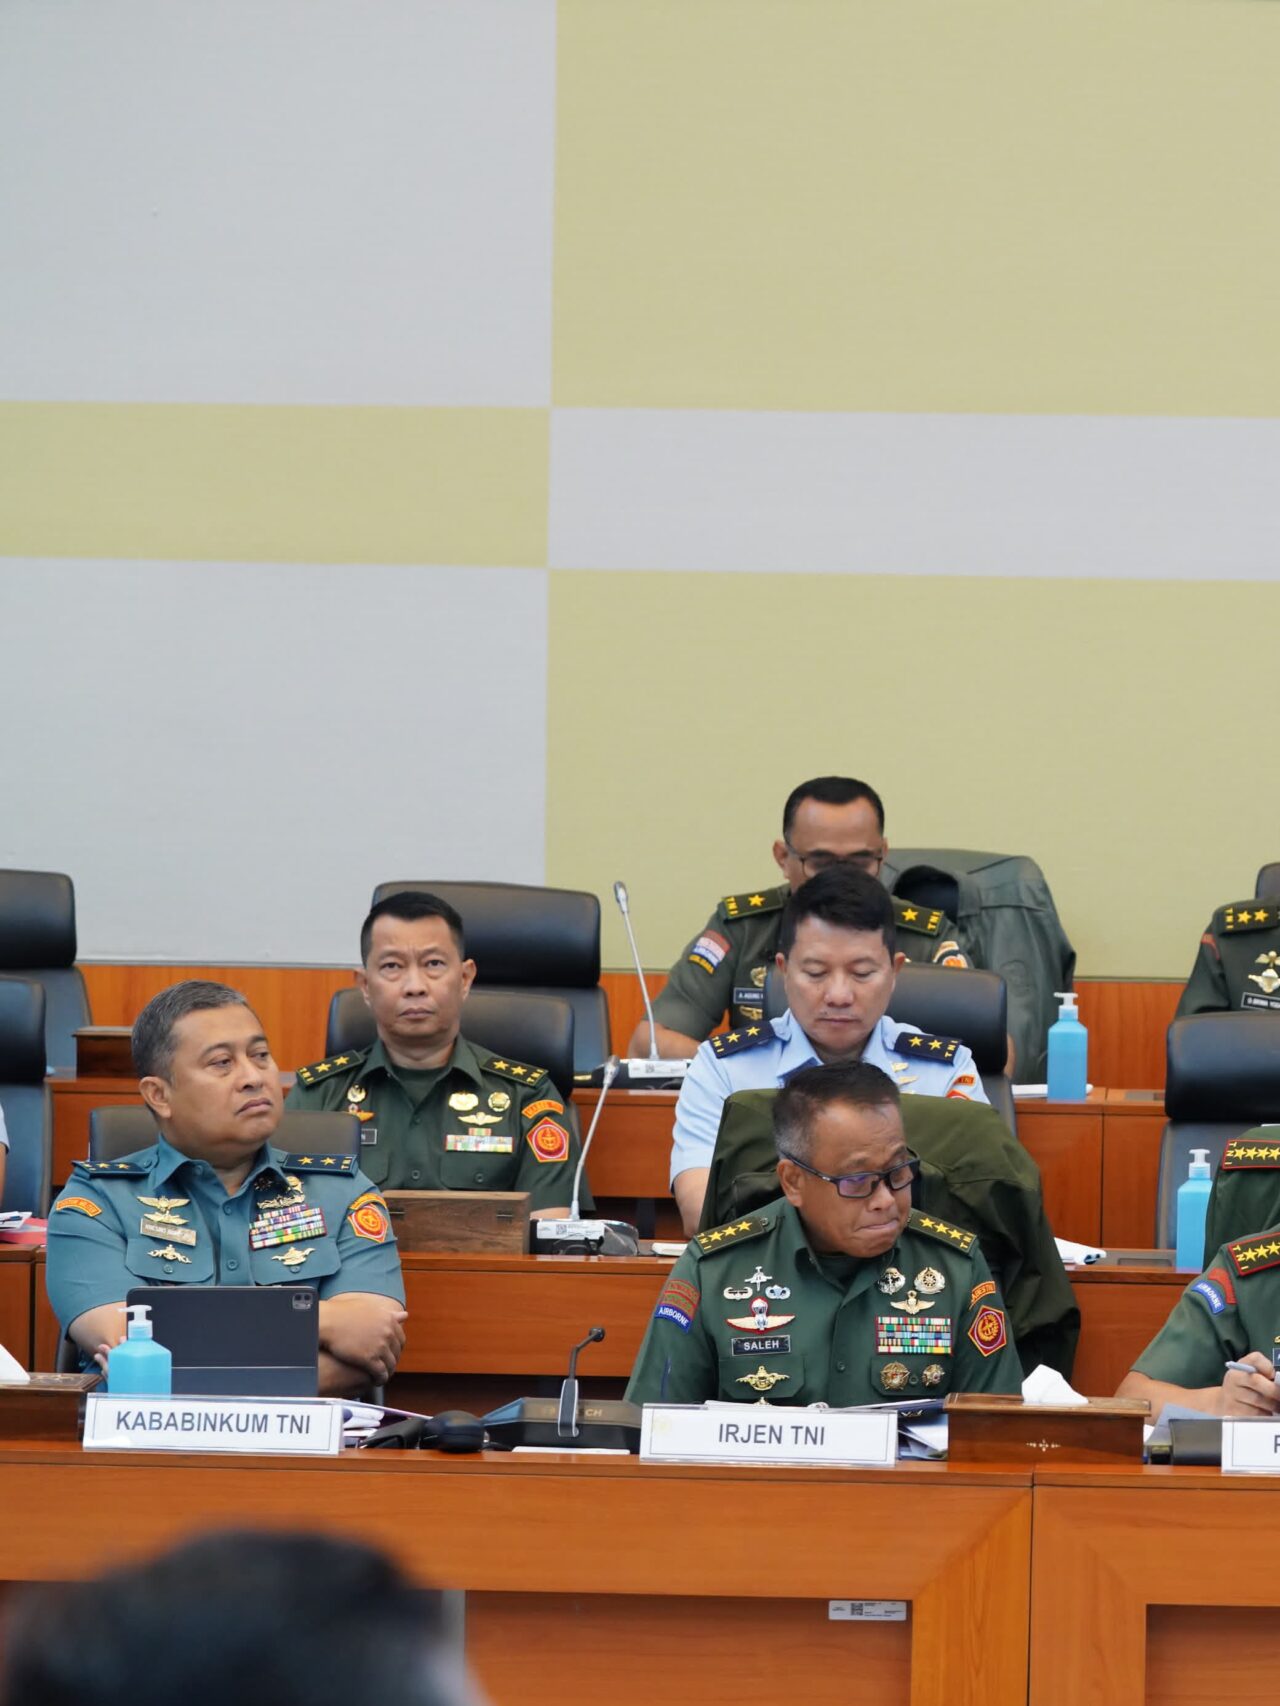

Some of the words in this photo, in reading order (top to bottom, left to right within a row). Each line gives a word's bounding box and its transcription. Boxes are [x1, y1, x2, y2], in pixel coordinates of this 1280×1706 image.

[658, 1306, 690, 1327] AIRBORNE
[743, 1339, 780, 1352] SALEH
[116, 1410, 271, 1434] KABABINKUM
[276, 1412, 311, 1434] TNI
[718, 1424, 783, 1445] IRJEN
[790, 1426, 825, 1446] TNI
